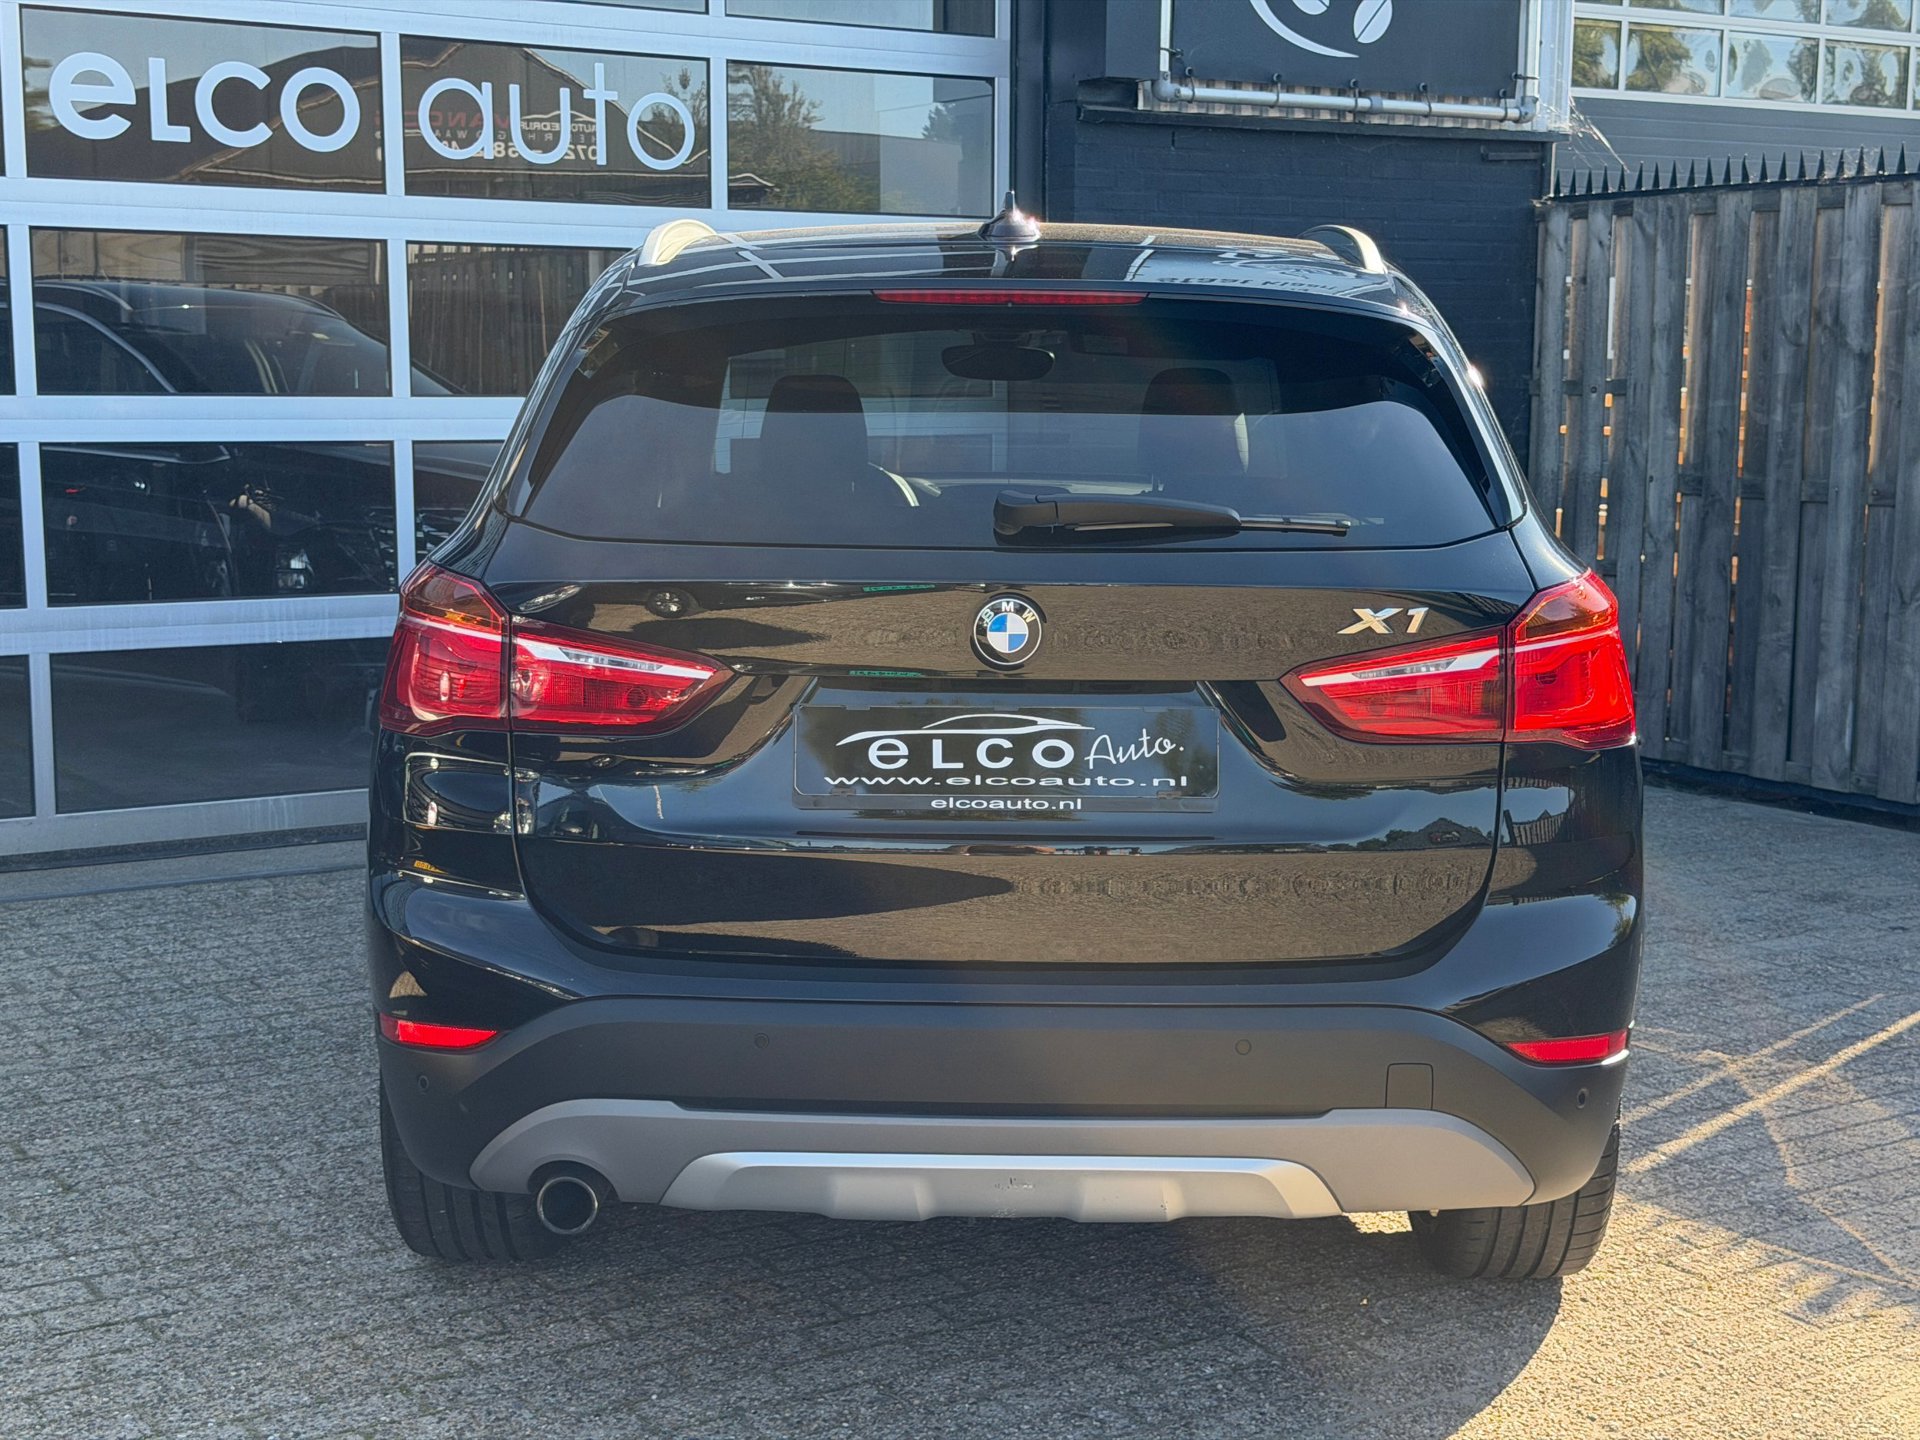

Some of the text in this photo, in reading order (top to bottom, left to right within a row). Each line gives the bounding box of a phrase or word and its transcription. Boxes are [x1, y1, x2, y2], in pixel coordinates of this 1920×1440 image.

[418, 62, 696, 171] auto
[981, 601, 1036, 623] BMW
[1336, 606, 1430, 634] X1
[824, 774, 1188, 787] www.elcoauto.nl
[930, 796, 1083, 811] elcoauto.nl
